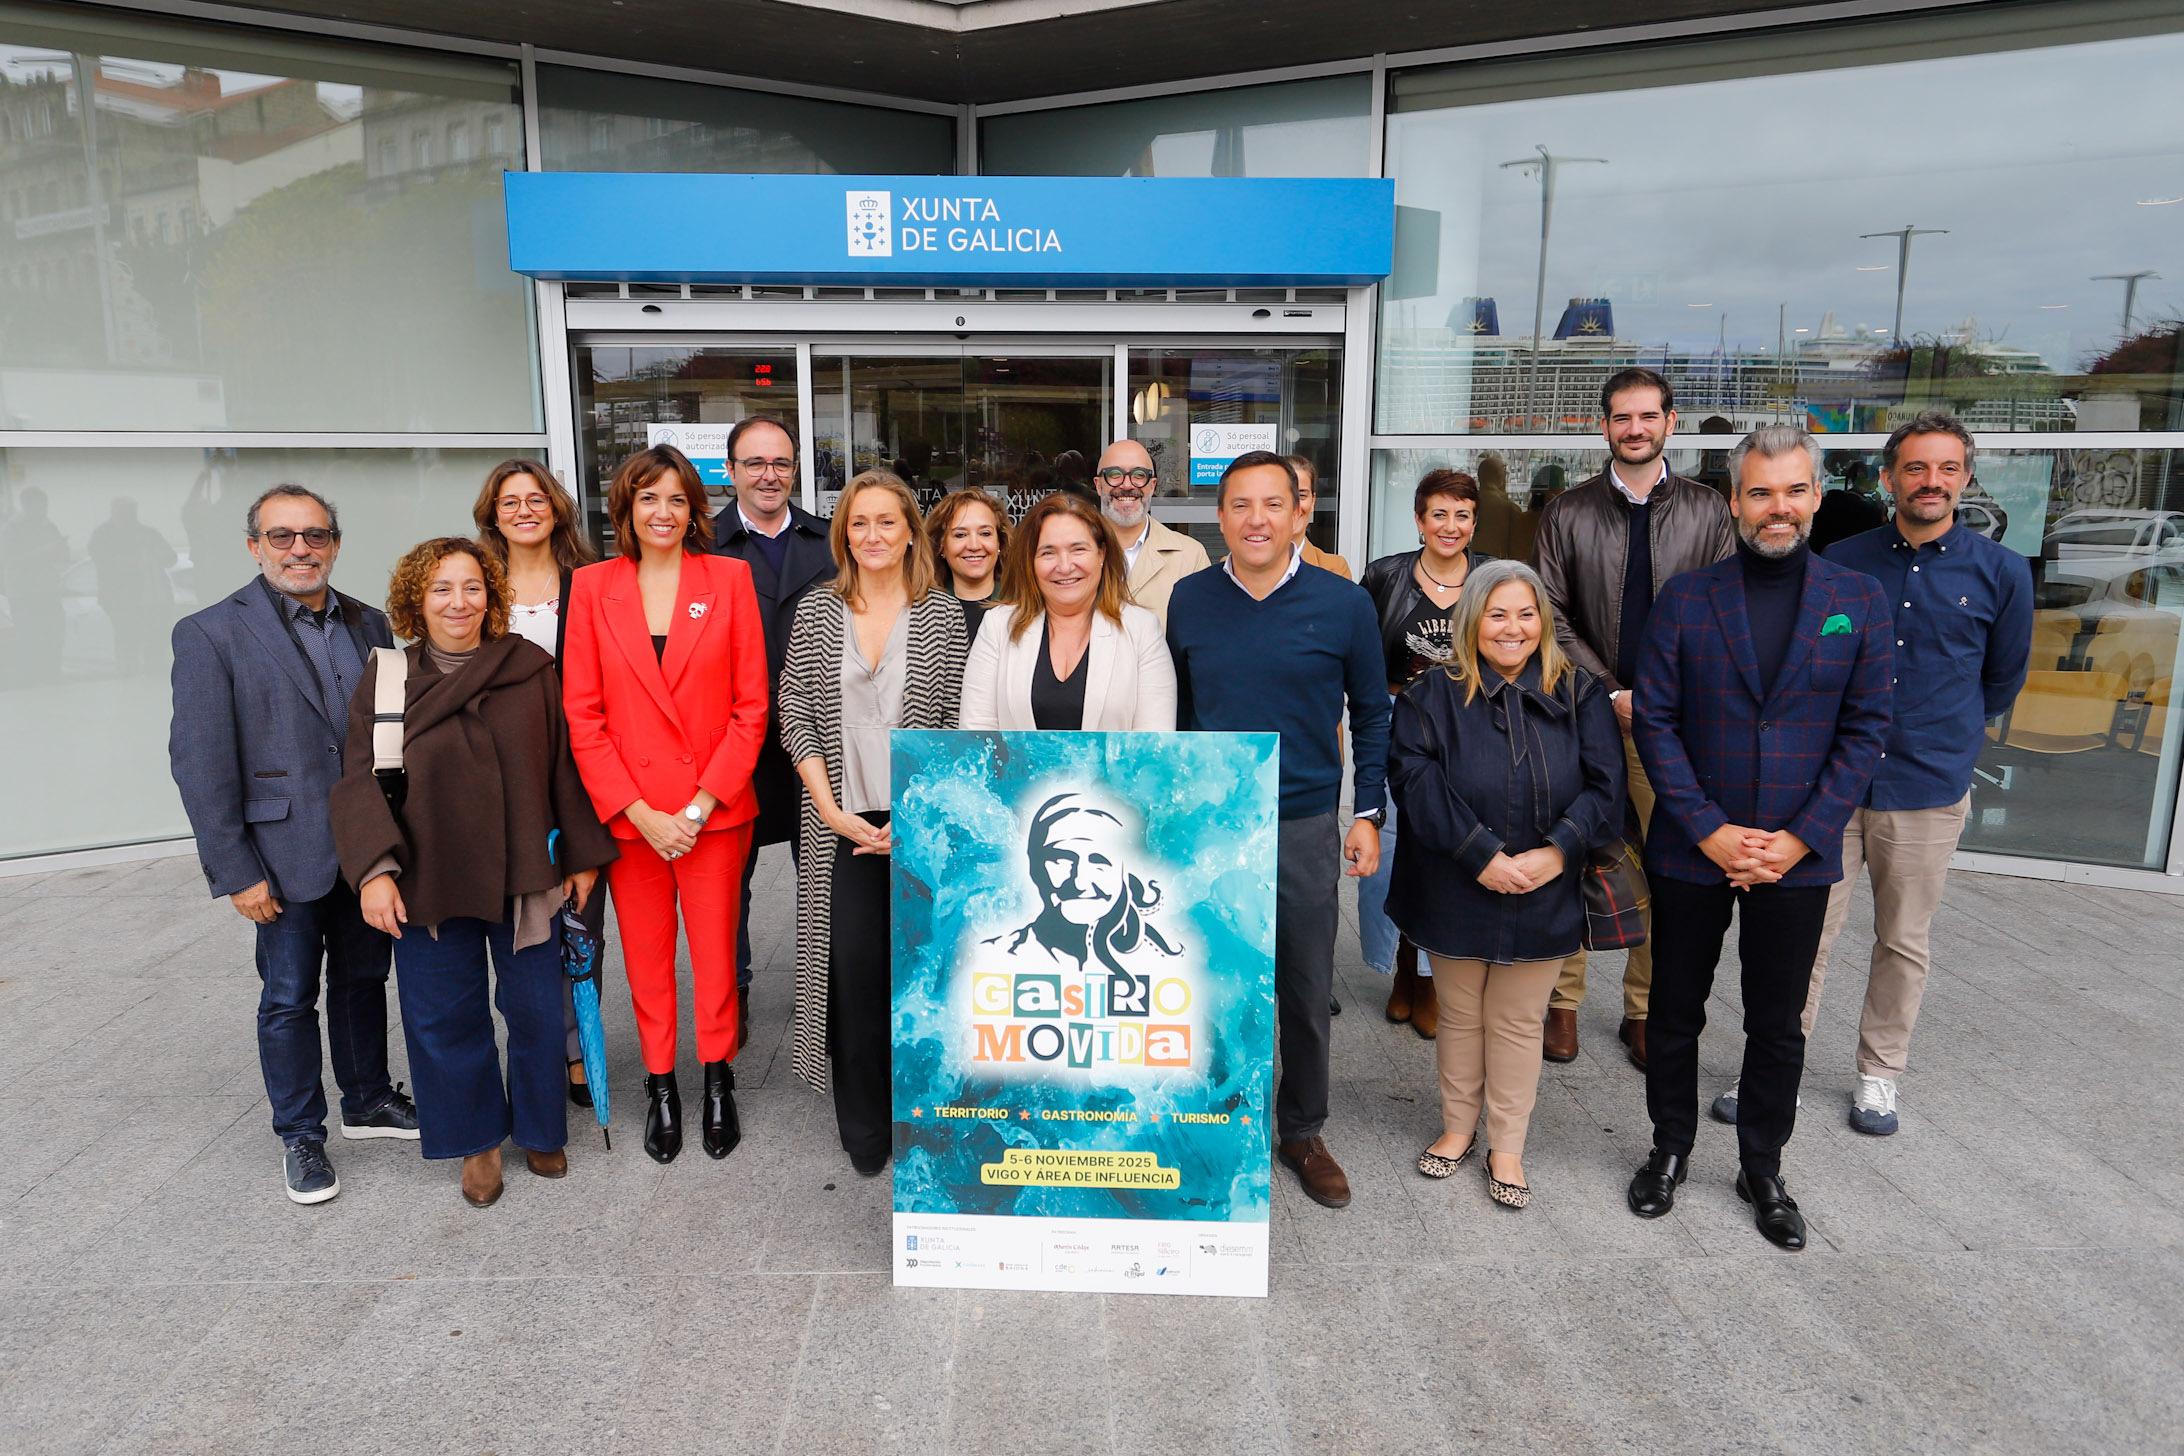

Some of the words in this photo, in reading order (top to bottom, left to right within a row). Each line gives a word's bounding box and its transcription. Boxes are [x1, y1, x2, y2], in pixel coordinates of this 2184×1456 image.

[902, 197, 1000, 221] XUNTA
[902, 228, 938, 251] DE
[948, 228, 1062, 252] GALICIA
[685, 432, 695, 440] Só
[698, 432, 728, 441] persoal
[1227, 431, 1236, 440] Só
[1239, 432, 1270, 442] persoal
[1227, 442, 1270, 450] autorizado
[1197, 463, 1223, 471] Entrada
[1197, 471, 1215, 479] porta
[934, 1106, 1009, 1120] TERRITORIO
[1041, 1109, 1138, 1123] GASTRONOMÍA
[1170, 1112, 1230, 1125] TURISMO
[1009, 1154, 1033, 1165] 5-6
[1036, 1154, 1116, 1167] NOVIEMBRE
[1118, 1156, 1152, 1168] 2025
[986, 1169, 1021, 1180] VIGO
[1023, 1170, 1033, 1181] Y
[1035, 1167, 1072, 1182] ÁREA
[1074, 1171, 1093, 1182] DE
[1095, 1171, 1175, 1185] INFLUENCIA
